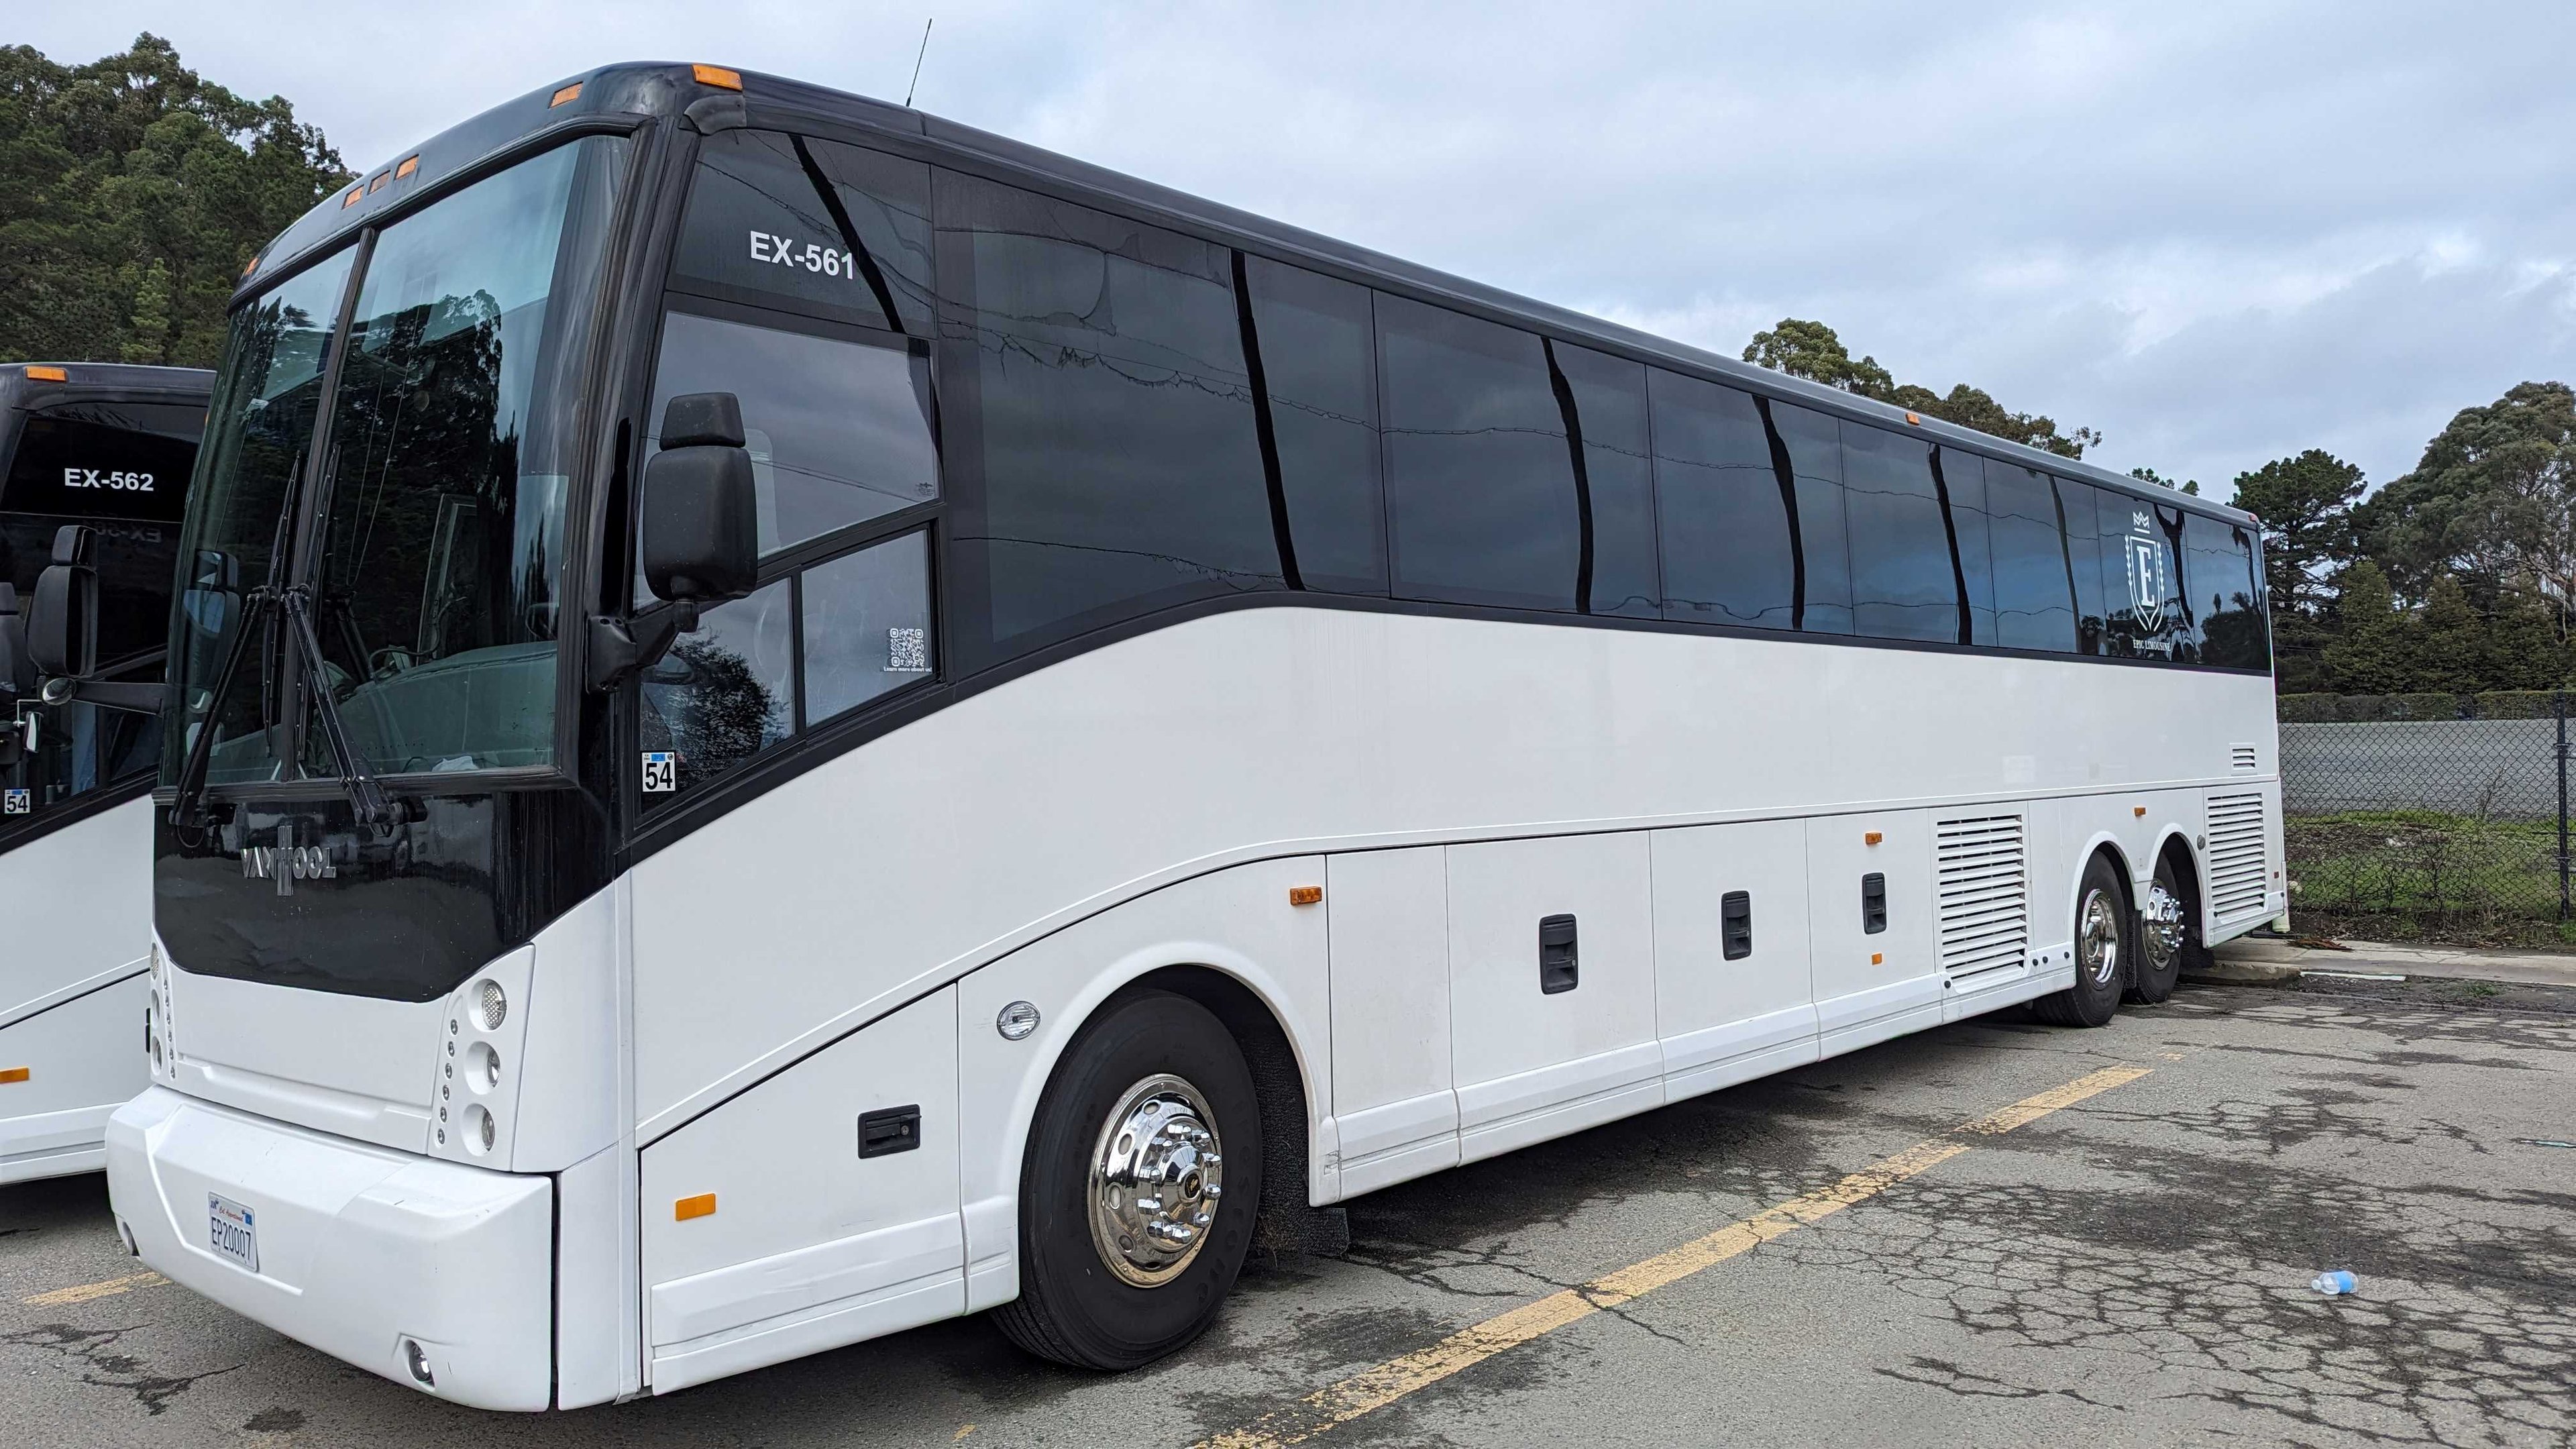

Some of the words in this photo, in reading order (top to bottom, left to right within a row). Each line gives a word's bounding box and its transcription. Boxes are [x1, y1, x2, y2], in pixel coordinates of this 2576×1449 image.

[750, 230, 854, 280] EX-561
[64, 468, 154, 492] EX-562
[2137, 545, 2155, 608] E
[2133, 639, 2145, 649] EPIC
[2145, 640, 2171, 651] LIMOUSINE
[645, 761, 673, 790] 54
[6, 795, 28, 812] 54
[211, 1216, 251, 1261] EP20007
